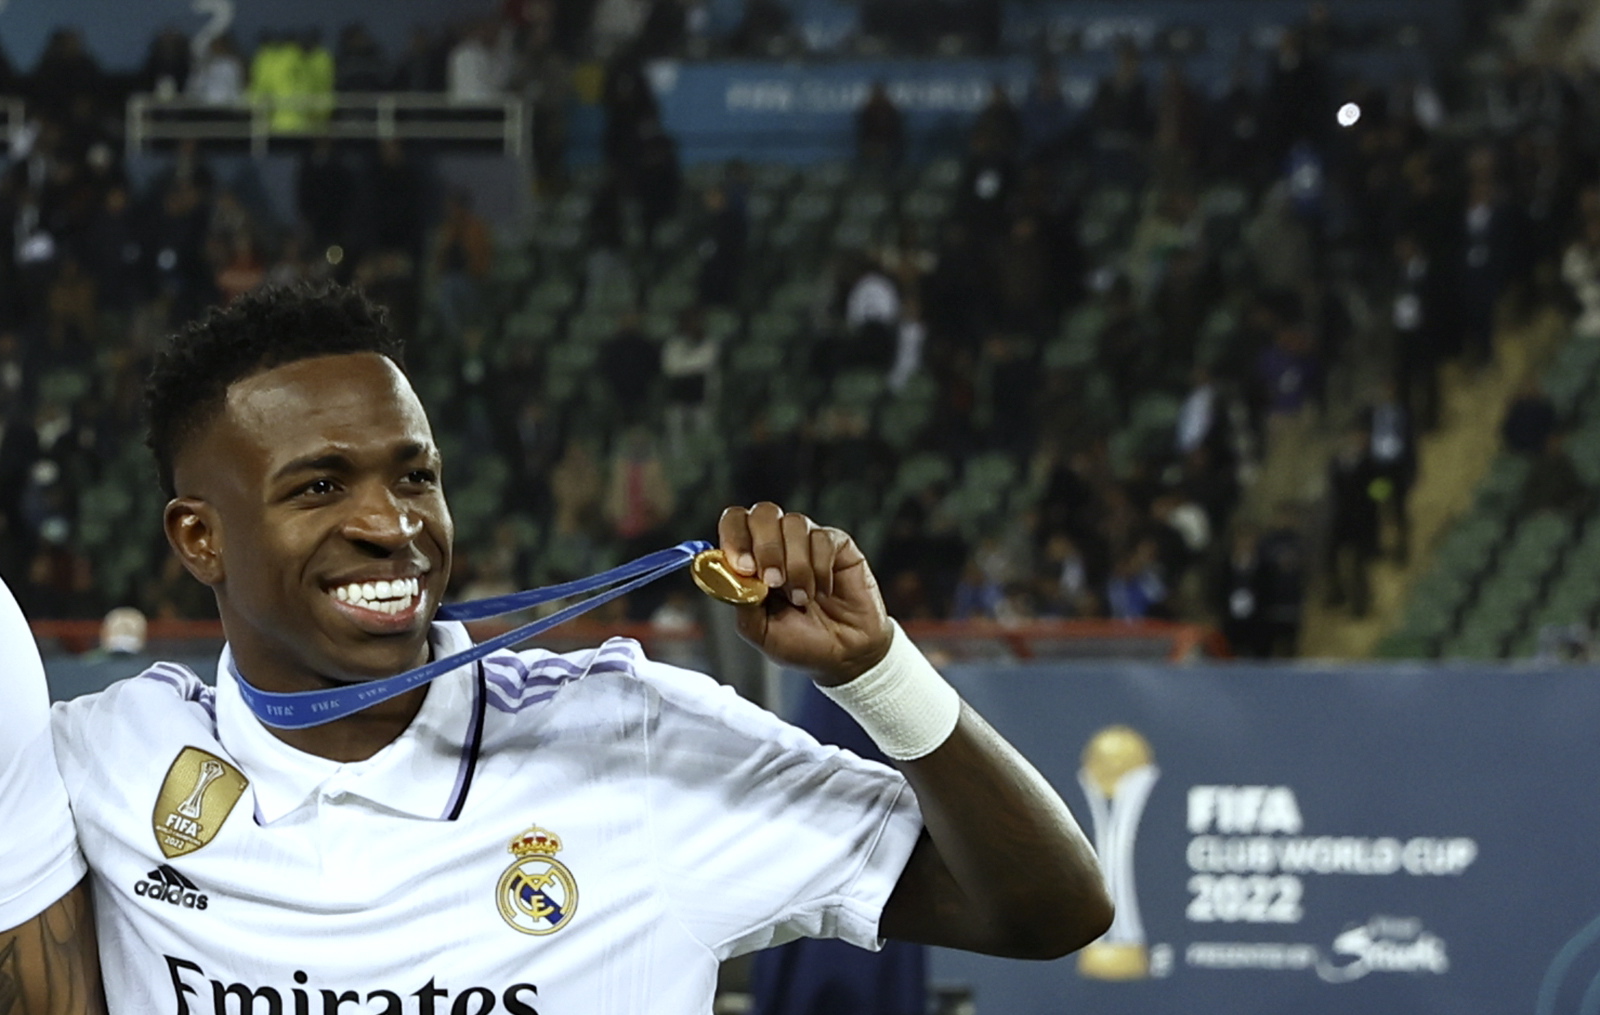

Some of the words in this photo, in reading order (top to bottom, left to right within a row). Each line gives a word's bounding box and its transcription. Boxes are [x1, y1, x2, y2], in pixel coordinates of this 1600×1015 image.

[165, 813, 198, 838] FIFA
[1187, 785, 1303, 834] FIFA
[1187, 835, 1279, 874] CLUB
[1278, 837, 1401, 875] WORLD
[1402, 837, 1478, 876] CUP
[134, 880, 209, 911] adidas
[1186, 873, 1304, 923] 2022
